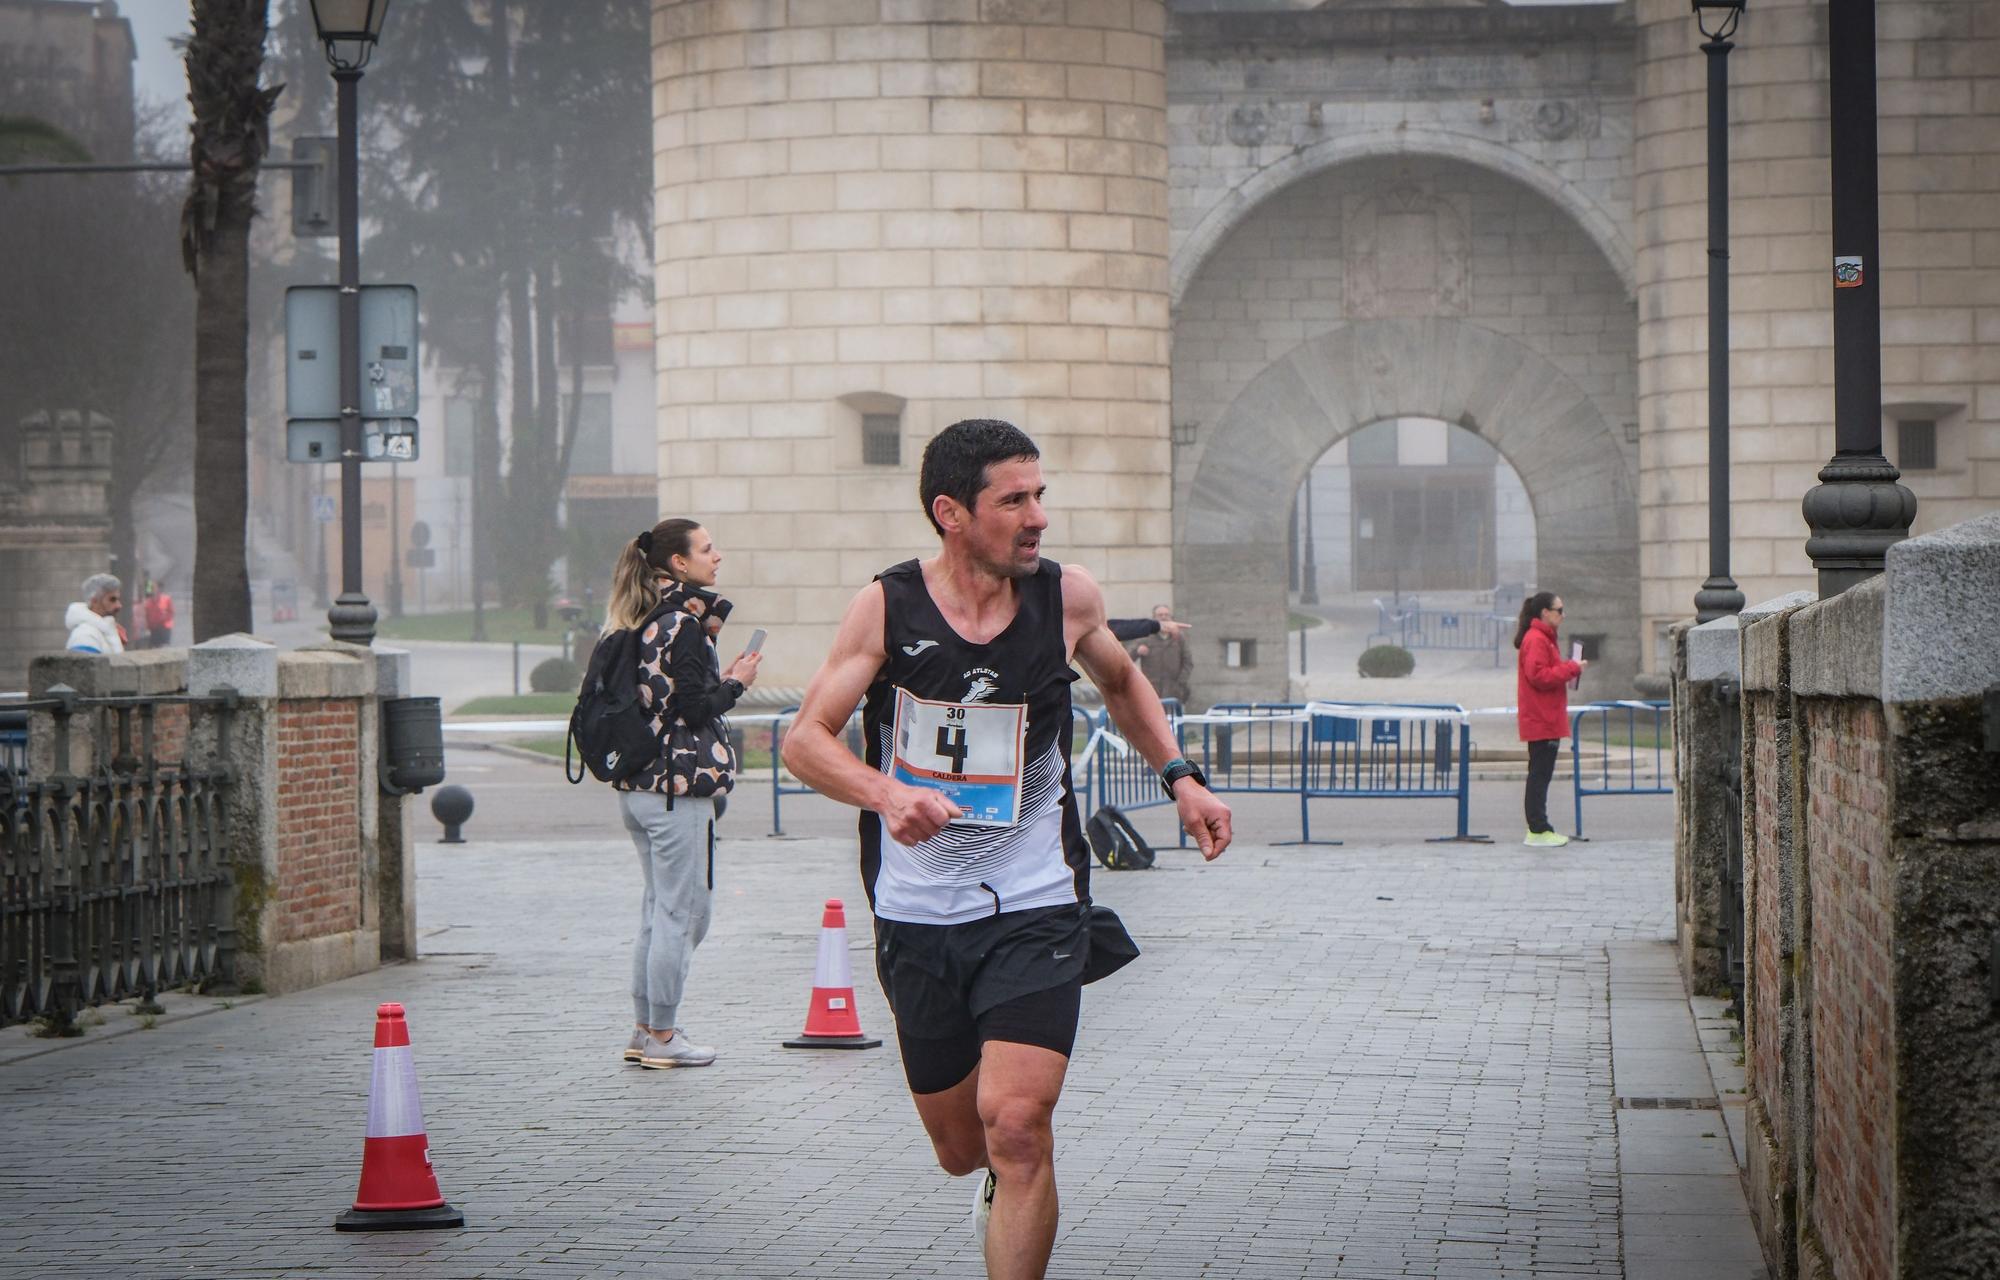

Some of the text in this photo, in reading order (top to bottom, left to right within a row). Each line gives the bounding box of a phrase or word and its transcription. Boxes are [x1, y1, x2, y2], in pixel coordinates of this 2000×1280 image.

[947, 707, 966, 720] 30
[936, 726, 968, 773] 4
[932, 771, 967, 782] CALDERA
